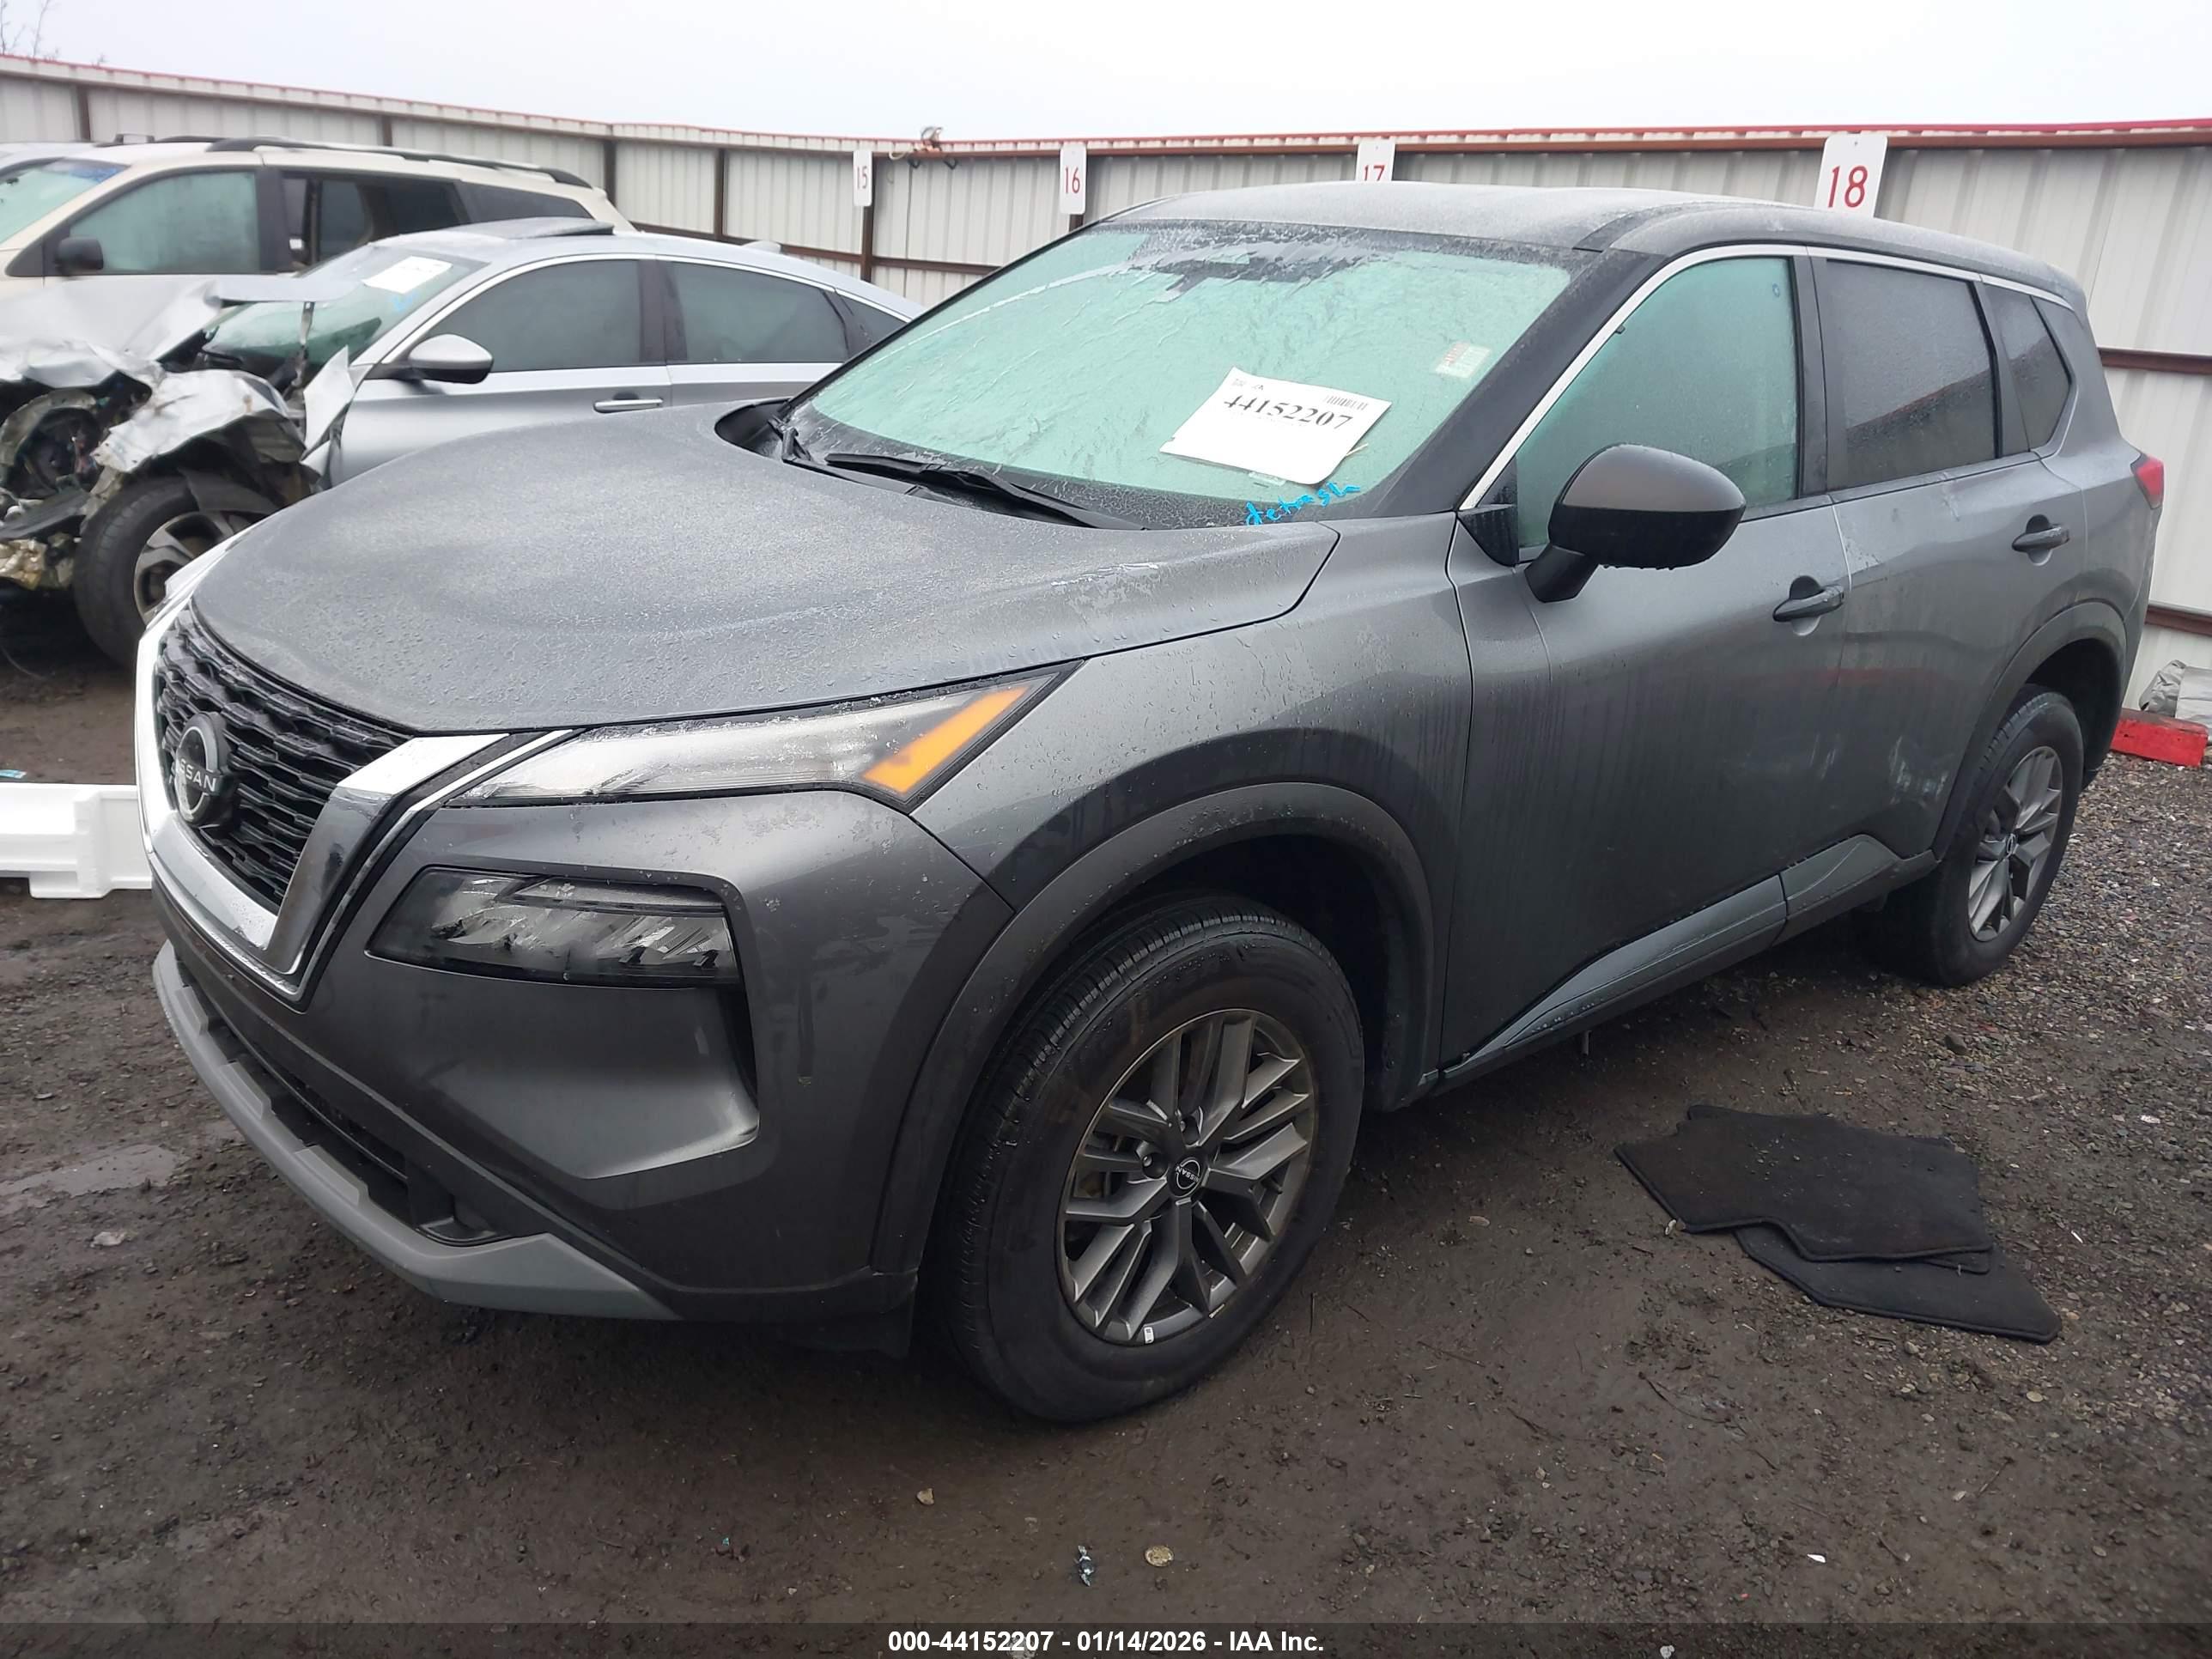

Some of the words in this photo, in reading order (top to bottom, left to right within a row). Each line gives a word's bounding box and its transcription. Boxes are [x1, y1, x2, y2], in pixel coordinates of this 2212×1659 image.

[857, 166, 868, 190] 15
[1065, 167, 1080, 194] 16
[1364, 165, 1385, 181] 17
[1827, 165, 1869, 208] 18
[1224, 394, 1354, 430] 44152207
